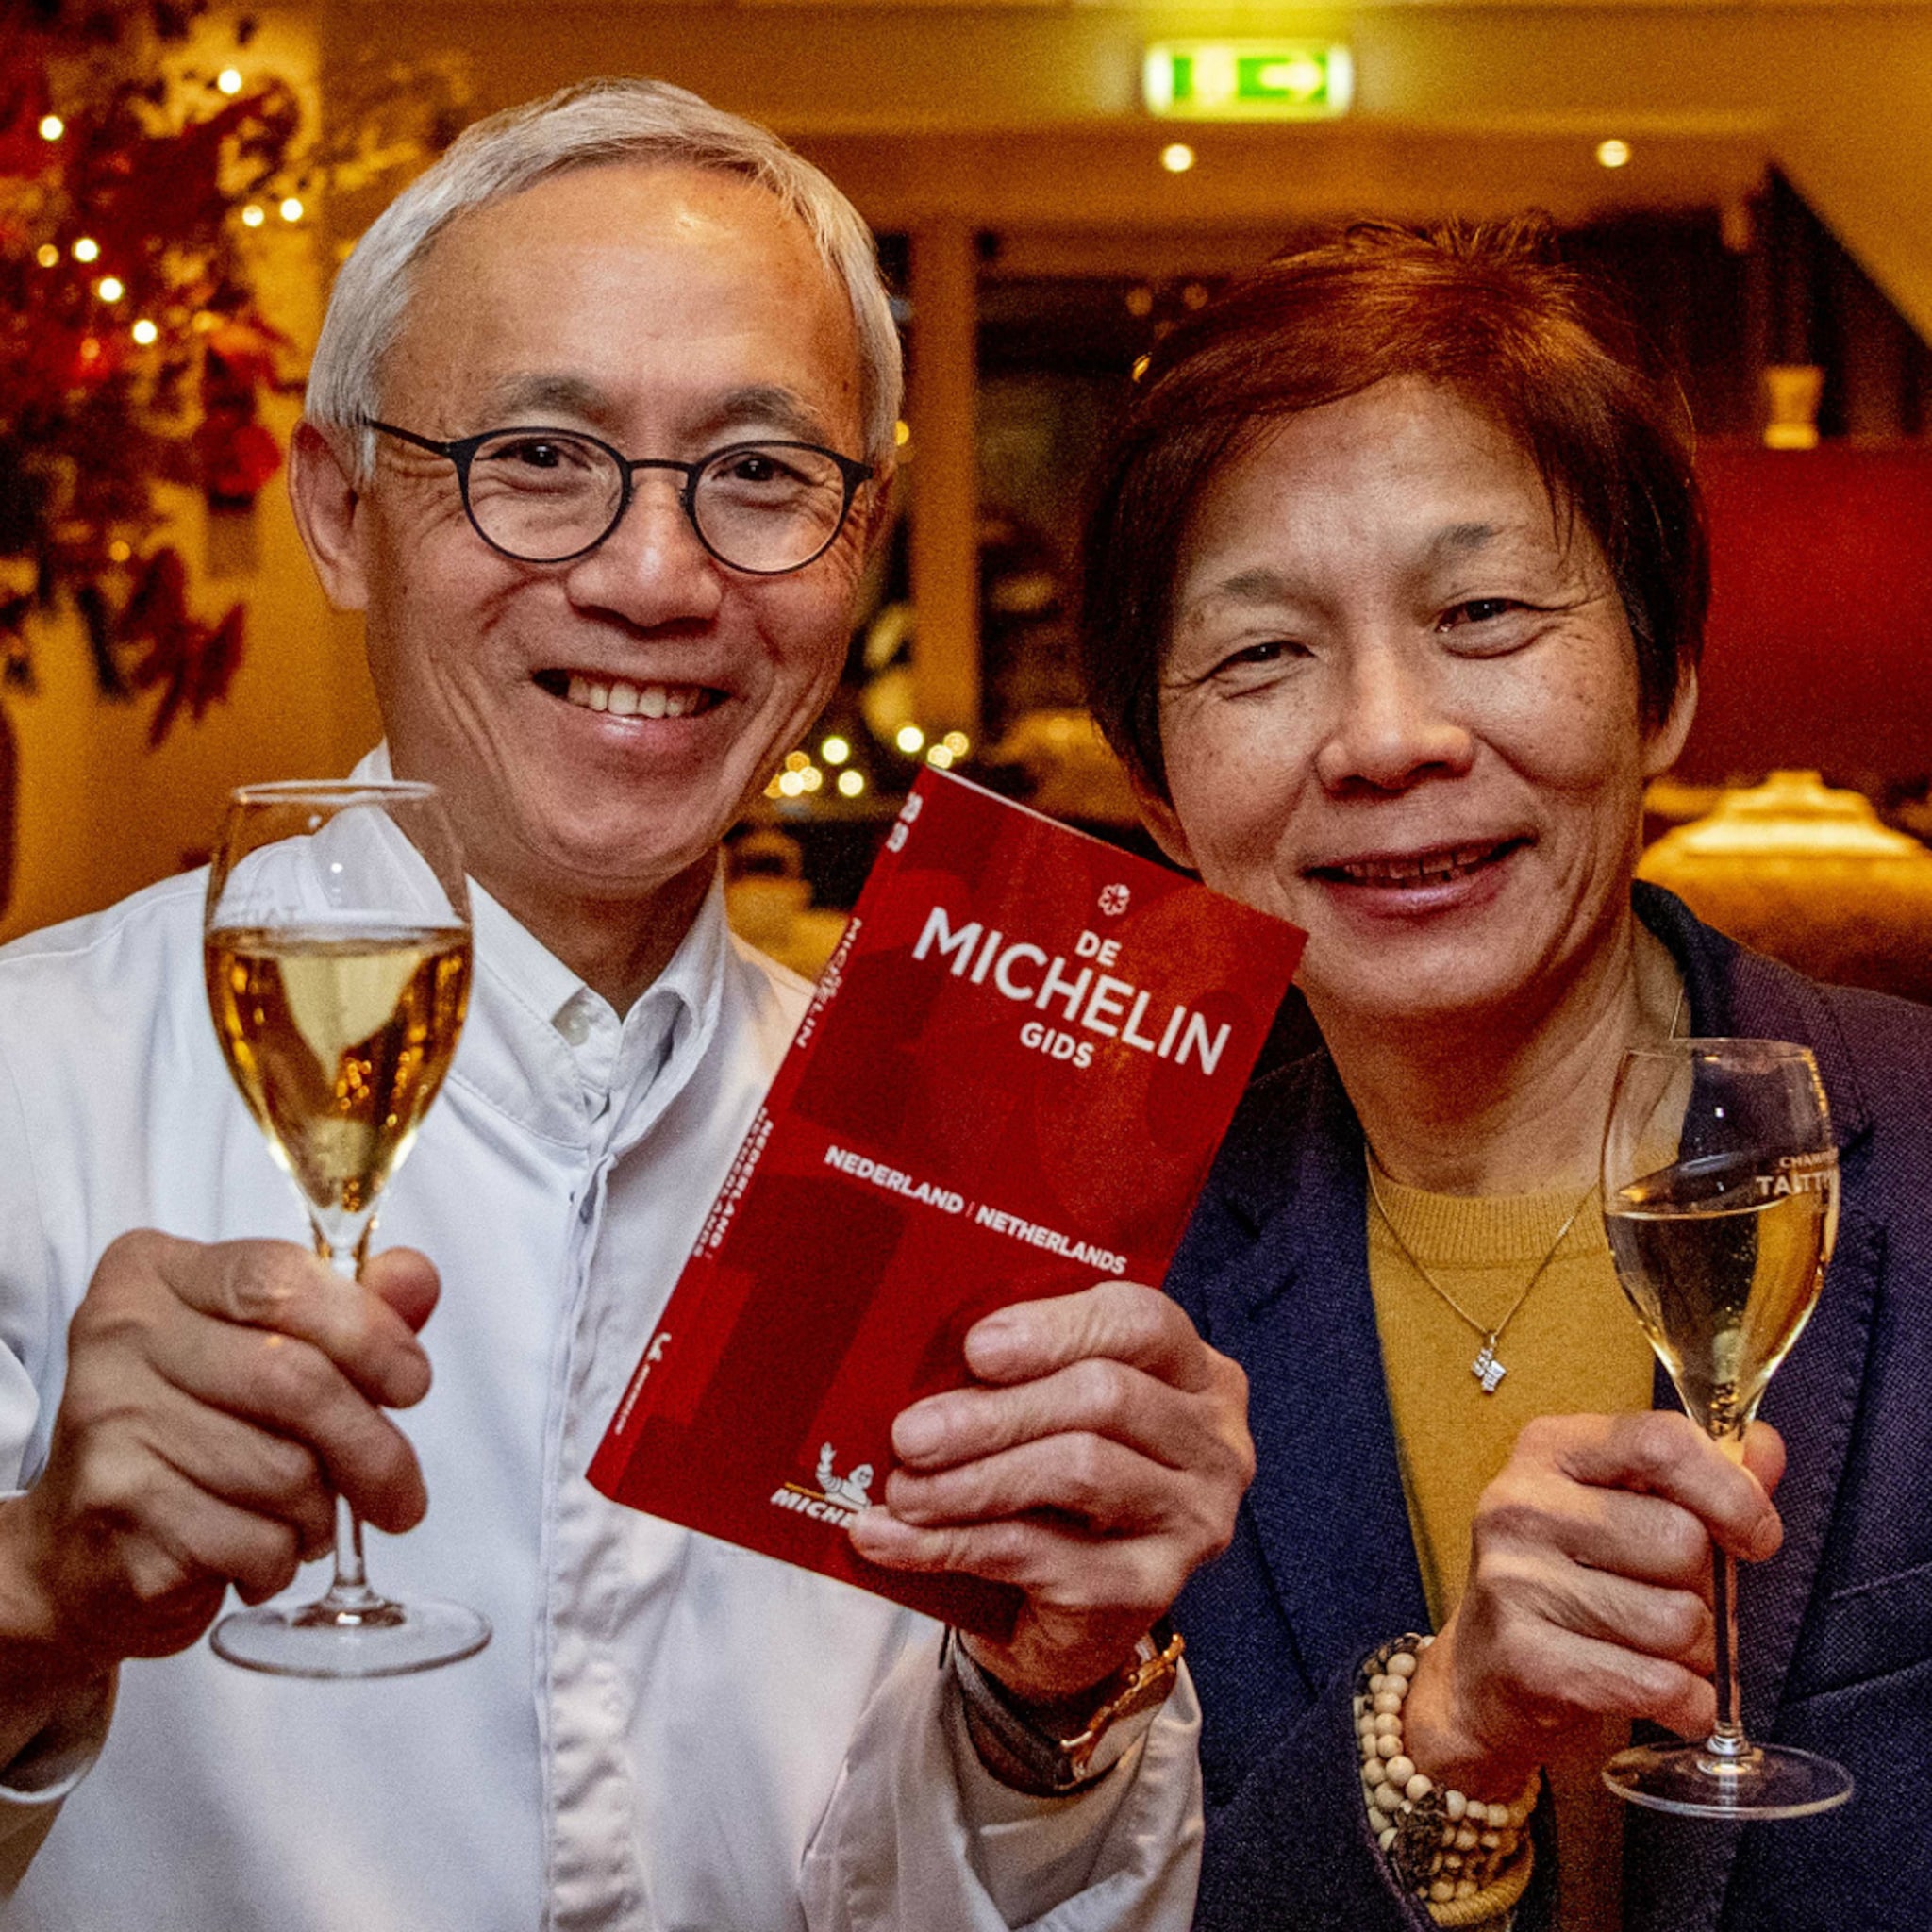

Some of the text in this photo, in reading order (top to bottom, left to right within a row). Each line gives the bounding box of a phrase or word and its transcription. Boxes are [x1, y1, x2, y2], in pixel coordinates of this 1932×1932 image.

[911, 906, 1231, 1075] MICHELIN
[1074, 929, 1122, 967] DE
[1019, 1021, 1095, 1069] GIDS
[824, 1144, 964, 1215] NEDERLAND
[974, 1204, 1127, 1275] NETHERLANDS
